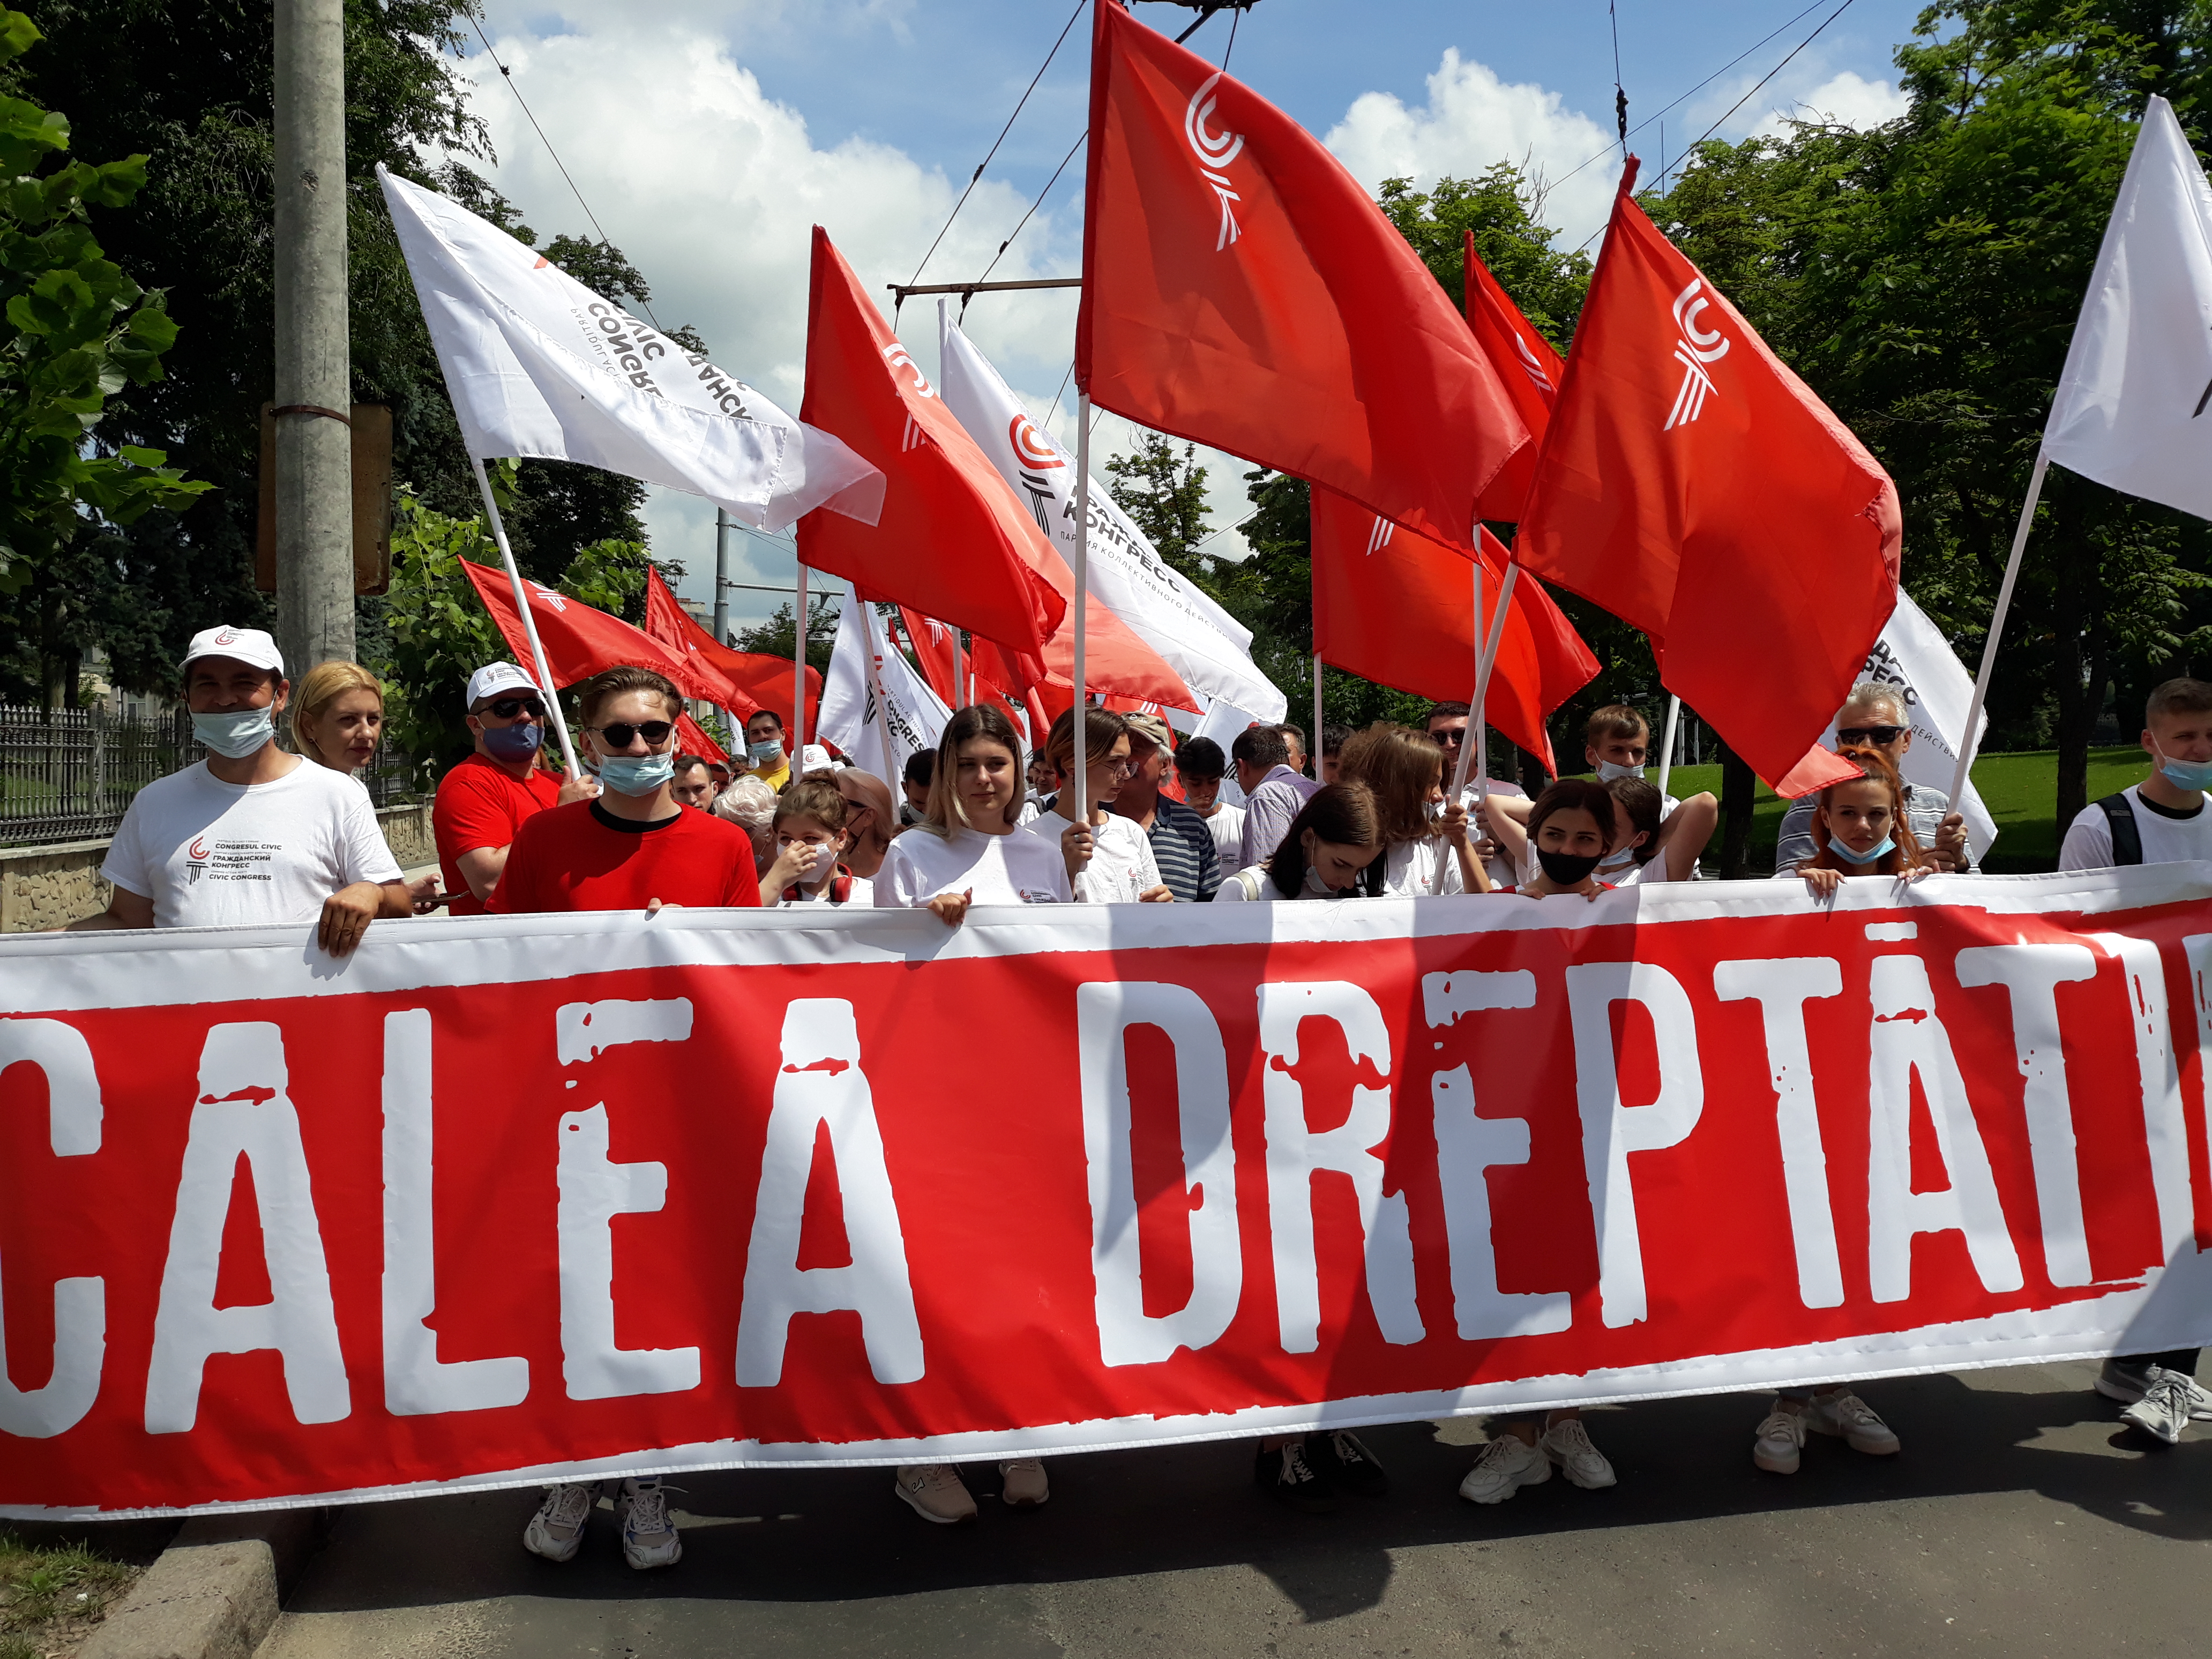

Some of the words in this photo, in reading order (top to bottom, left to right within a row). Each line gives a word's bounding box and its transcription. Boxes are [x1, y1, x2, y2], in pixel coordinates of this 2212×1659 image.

[1060, 530, 1098, 550] ПАРИЯ
[1100, 547, 1183, 609] КОЛЛЕКТИВНОГО
[1911, 724, 1959, 763] ДЕЙСТВИ
[0, 997, 925, 1439] CALEA
